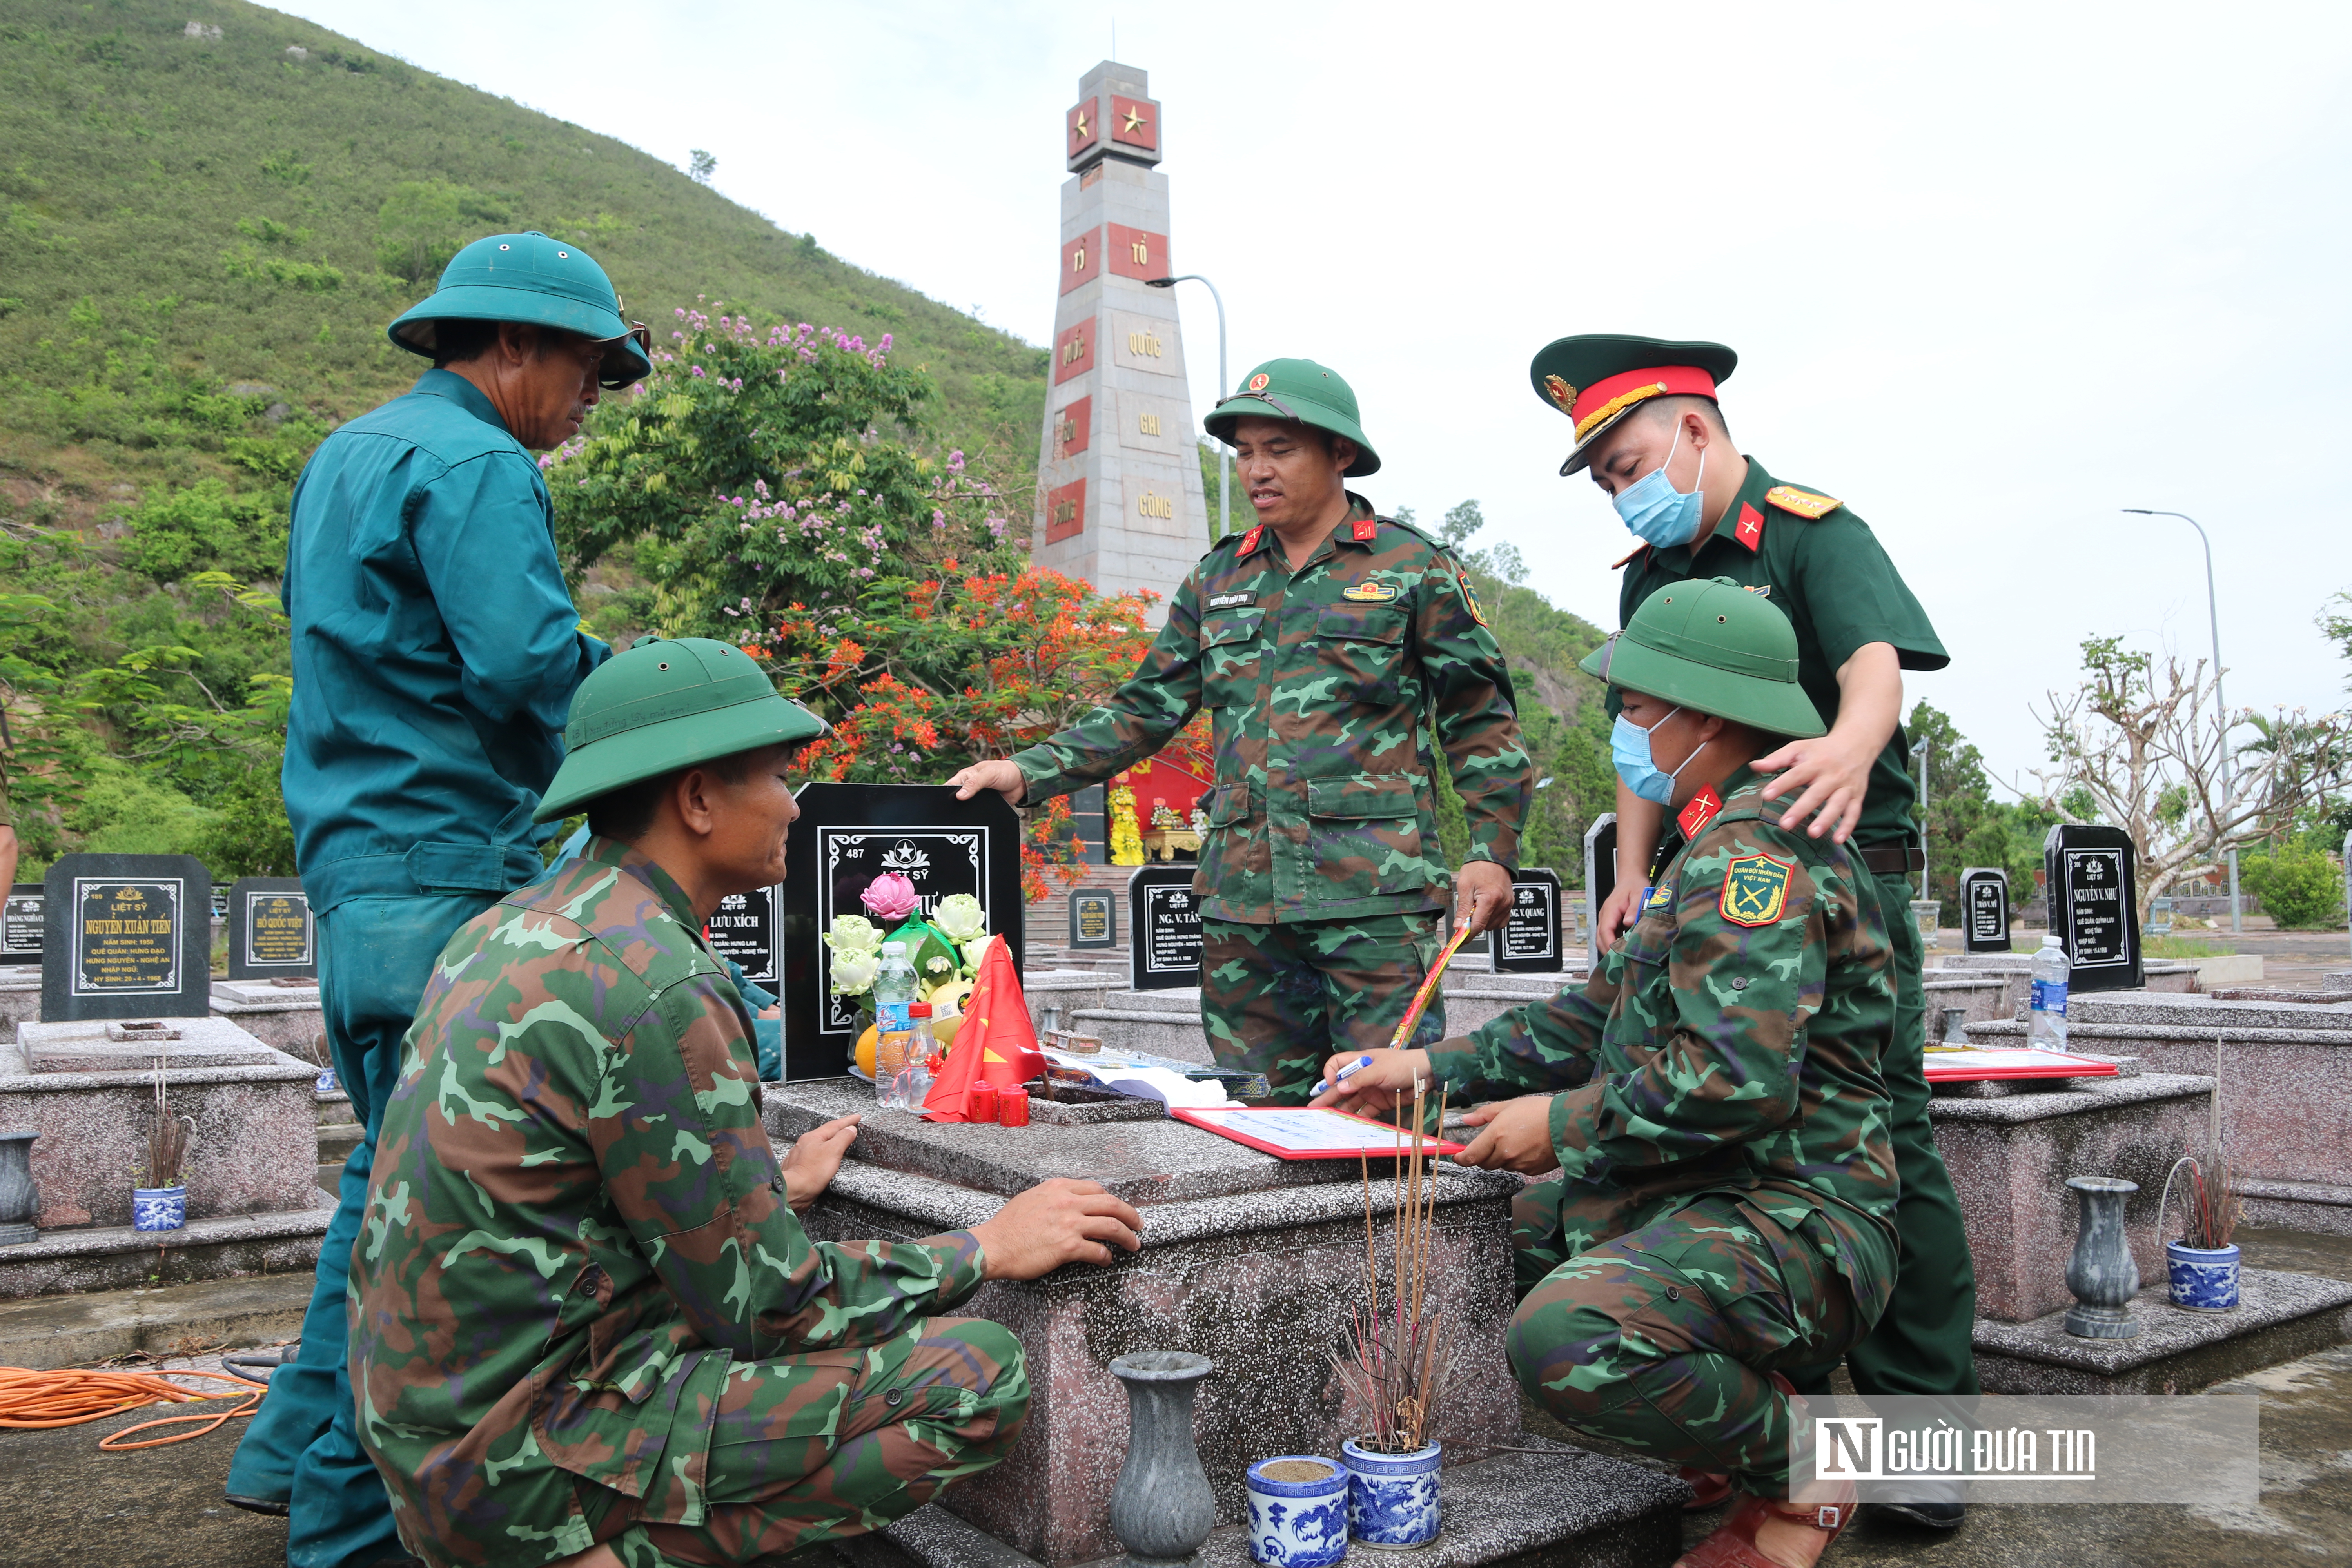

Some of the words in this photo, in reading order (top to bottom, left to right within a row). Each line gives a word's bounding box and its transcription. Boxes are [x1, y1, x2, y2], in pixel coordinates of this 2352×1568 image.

[1074, 237, 1085, 272] TỔ
[1131, 234, 1147, 265] TỔ
[1062, 328, 1085, 368] QUỐC
[1139, 413, 1160, 436] GHI
[1054, 498, 1076, 526] CÔNG
[1138, 491, 1172, 519] CÔNG
[1210, 595, 1229, 606] NGUYỄN
[1229, 595, 1238, 604] HỮU
[1238, 594, 1248, 603] THỌ
[846, 849, 864, 858] 487
[912, 869, 929, 880] SỸ
[111, 902, 132, 912] LIỆT
[134, 902, 147, 911] SỸ
[1520, 908, 1525, 916] V.
[1525, 908, 1544, 918] QUANG
[85, 912, 122, 934] NGUYỄN
[124, 915, 149, 934] XUÂN
[151, 913, 171, 934] TIẾN
[710, 915, 731, 927] LƯU
[733, 913, 759, 927] XÍCH
[1158, 914, 1174, 924] NG.
[1175, 914, 1183, 923] V.
